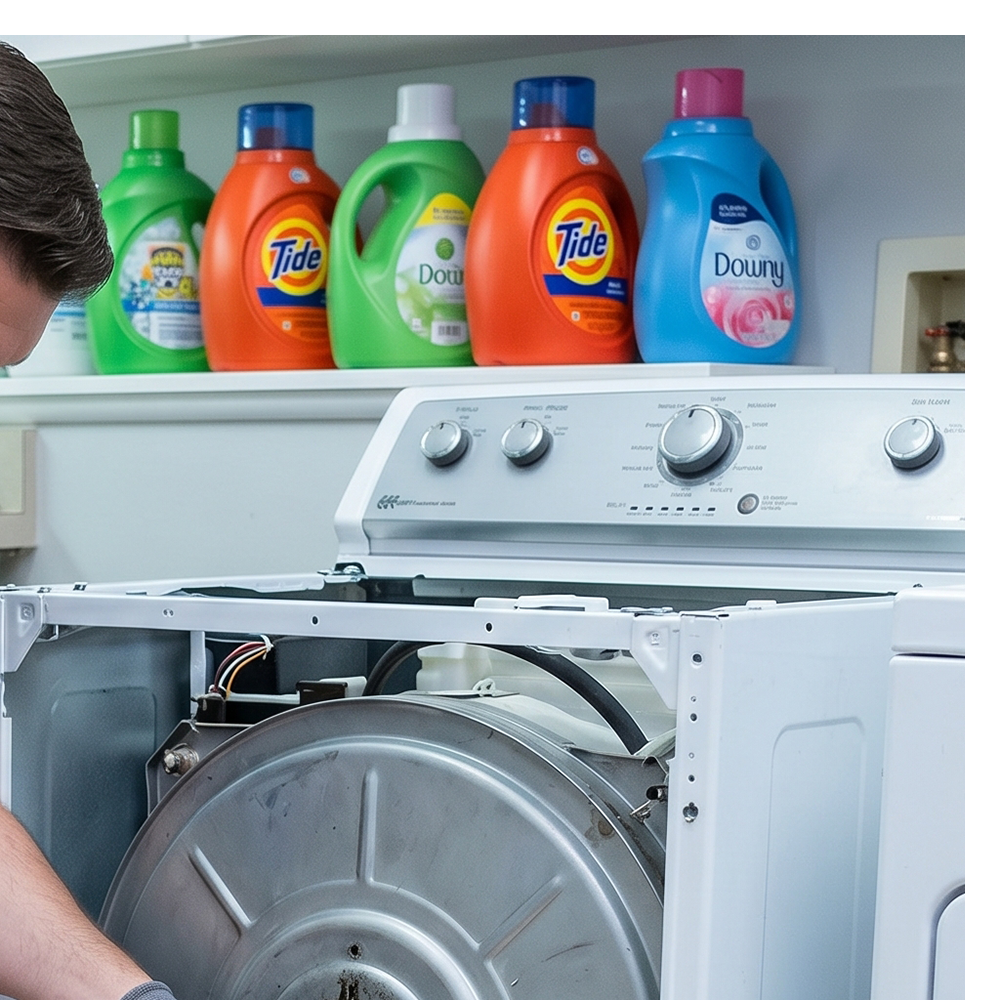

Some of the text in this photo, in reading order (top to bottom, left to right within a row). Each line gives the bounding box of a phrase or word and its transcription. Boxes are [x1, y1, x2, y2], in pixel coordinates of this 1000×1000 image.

[270, 238, 322, 280] Tide
[556, 221, 608, 267] Tide
[419, 263, 464, 285] Dow
[714, 252, 784, 288] Downy
